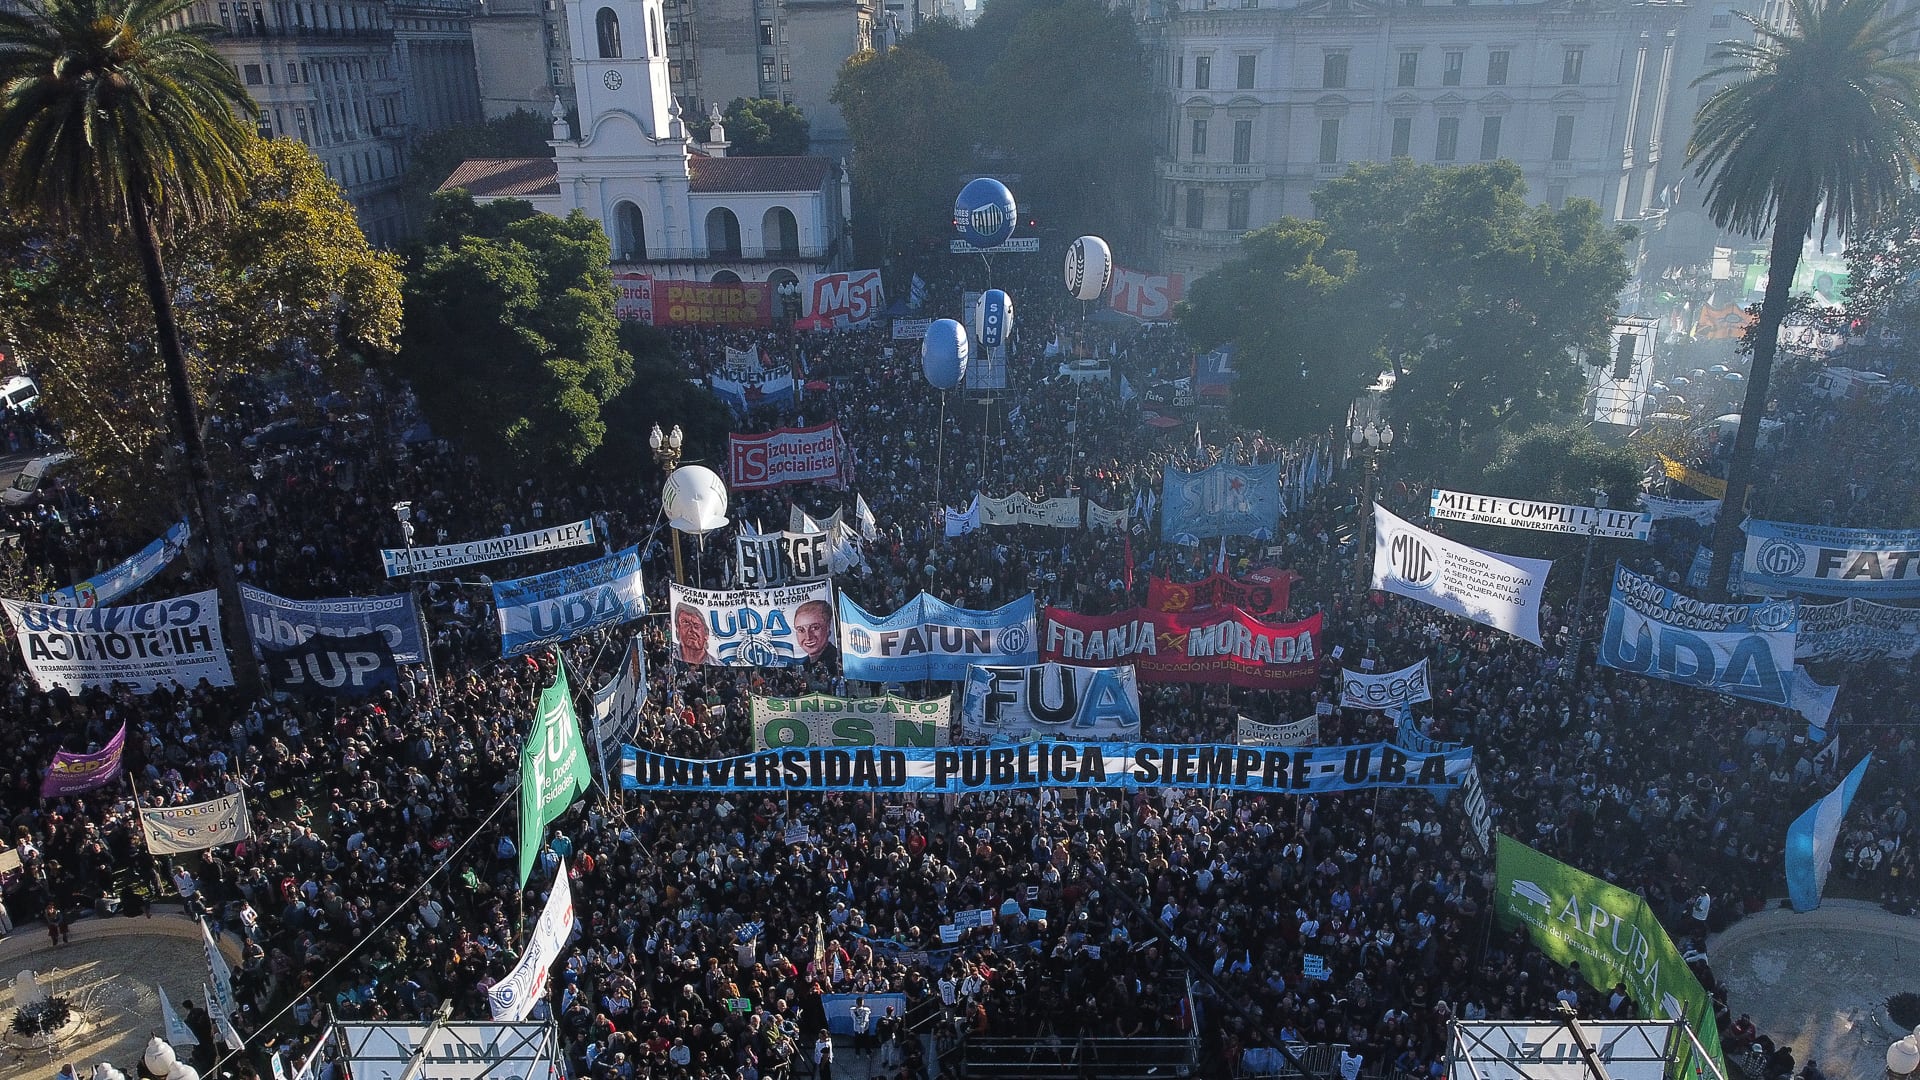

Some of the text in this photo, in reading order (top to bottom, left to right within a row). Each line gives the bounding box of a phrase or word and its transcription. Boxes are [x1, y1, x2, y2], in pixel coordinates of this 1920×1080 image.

[622, 286, 650, 301] erda
[667, 287, 762, 305] PARTIDO
[819, 275, 882, 319] MST
[1111, 267, 1169, 317] PTS
[668, 305, 758, 323] OBRERO
[987, 303, 998, 344] SOMU
[768, 437, 833, 459] izquierda
[769, 453, 835, 476] socialista
[1437, 508, 1466, 520] FRENTE
[1471, 513, 1507, 525] SINDICAL
[1511, 518, 1577, 533] UNIVERSITARIO
[1615, 530, 1635, 539] FUA
[1439, 492, 1501, 514] MILEI:
[1607, 513, 1638, 530] LEY
[533, 532, 551, 548] LA
[557, 523, 583, 543] LEY
[396, 562, 427, 575] FRENTE
[432, 557, 467, 570] SINDICAL
[740, 534, 829, 584] SURGE
[1391, 534, 1433, 583] MUC
[1444, 559, 1532, 586] PATRIOTAS NO VAN
[1454, 555, 1468, 563] NO
[1814, 548, 1920, 580] FAT
[712, 592, 722, 600] MI
[727, 591, 760, 600] NOMBRE
[764, 590, 770, 598] Y
[774, 589, 785, 598] LO
[1452, 570, 1468, 579] SER
[1469, 576, 1494, 589] NADA
[1496, 583, 1508, 592] EN
[1508, 586, 1520, 595] LA
[1466, 583, 1505, 601] QUIERAN
[1506, 596, 1513, 604] A
[1514, 597, 1526, 606] SU
[1616, 566, 1666, 604] SERGIO
[1672, 592, 1749, 624] ROMERO
[529, 585, 626, 638] UDA
[683, 593, 811, 607] COMO BANDERA A LA VICTORIA
[1624, 594, 1726, 631] CONDUCCION
[709, 607, 792, 638] UDA
[880, 624, 991, 656] FATUN
[1046, 618, 1314, 664] FRANJA MORADA
[1602, 598, 1788, 704] UDA
[1262, 667, 1315, 680] SIEMPRE
[1346, 668, 1425, 702] ceea
[767, 698, 939, 715] SINDICATO
[983, 666, 1141, 728] FUA
[1239, 728, 1312, 740] OCUPACIONAL
[635, 748, 906, 788] UNIVERSIDAD
[934, 743, 1106, 788] PUBLICA
[1133, 746, 1311, 789] SIEMPRE
[1508, 903, 1549, 935] Asociación
[1549, 925, 1563, 939] del
[1563, 931, 1599, 958] Personal
[1599, 952, 1612, 966] de
[1556, 894, 1660, 1001] APUBA
